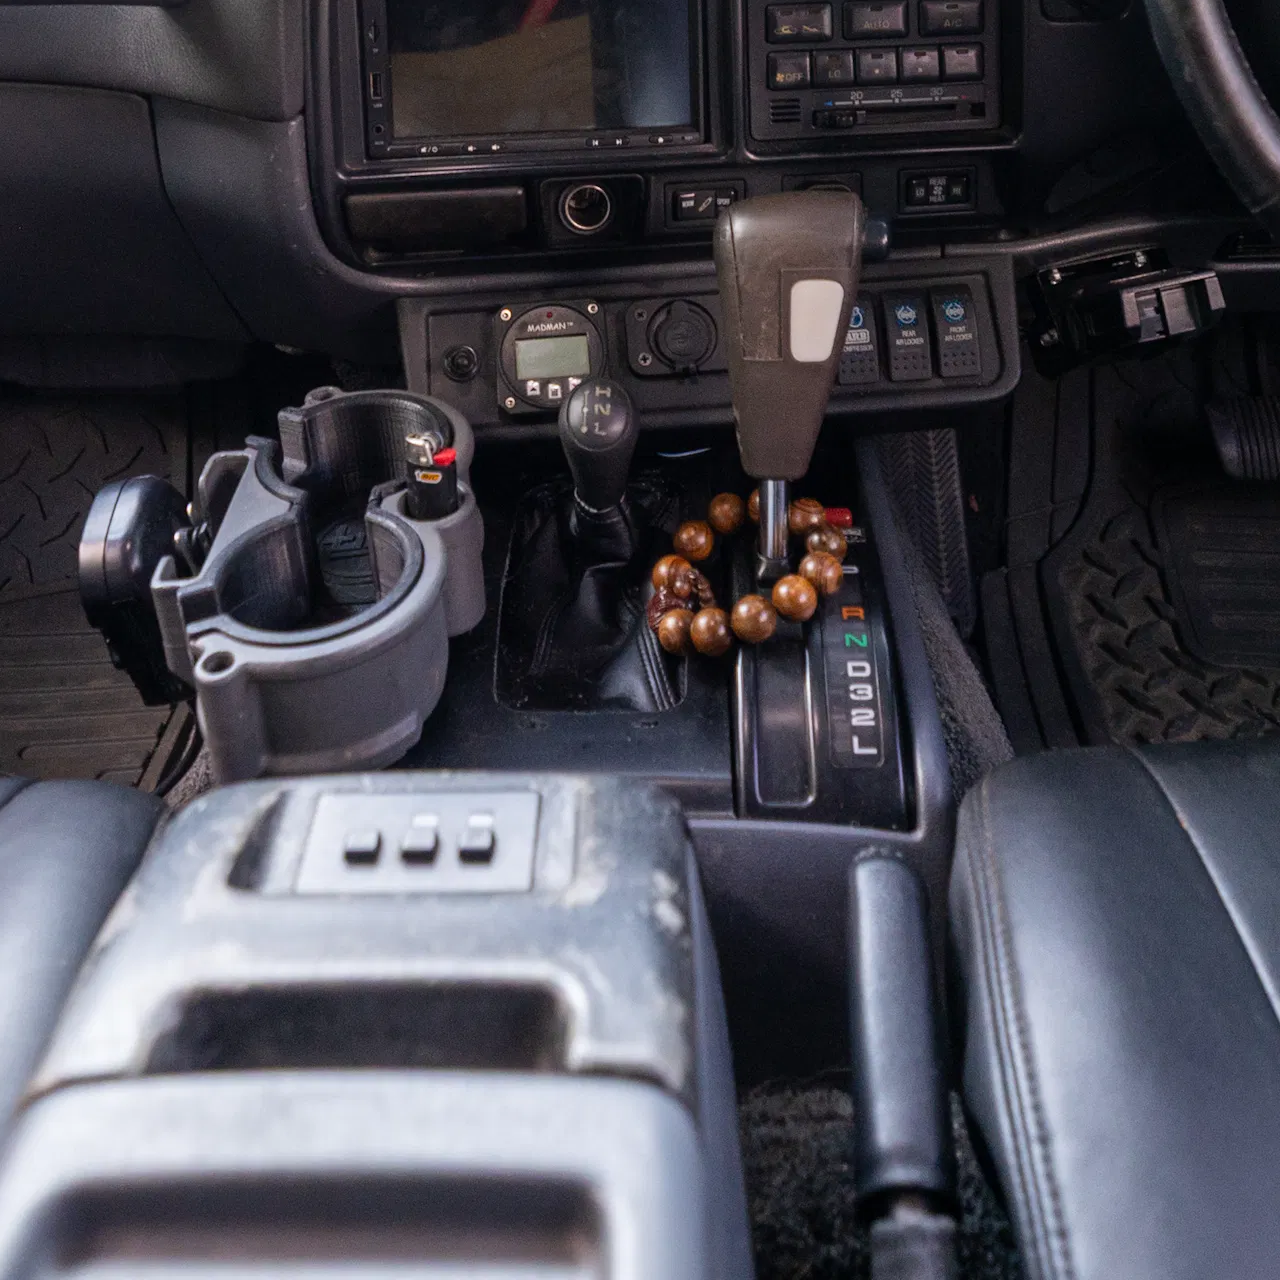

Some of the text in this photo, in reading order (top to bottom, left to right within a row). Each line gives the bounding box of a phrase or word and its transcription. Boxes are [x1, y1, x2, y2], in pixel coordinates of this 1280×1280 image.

[863, 20, 890, 29] AUTO
[944, 19, 962, 28] A/C
[785, 73, 804, 81] OFF
[850, 91, 864, 100] 20
[890, 89, 903, 99] 25
[930, 87, 943, 97] 30
[595, 386, 611, 397] H
[594, 404, 611, 416] N
[594, 422, 607, 436] L
[842, 606, 865, 620] R
[845, 633, 868, 648] N
[847, 661, 871, 677] D
[849, 683, 874, 701] 3
[851, 708, 876, 726] 2
[852, 735, 878, 755] L
